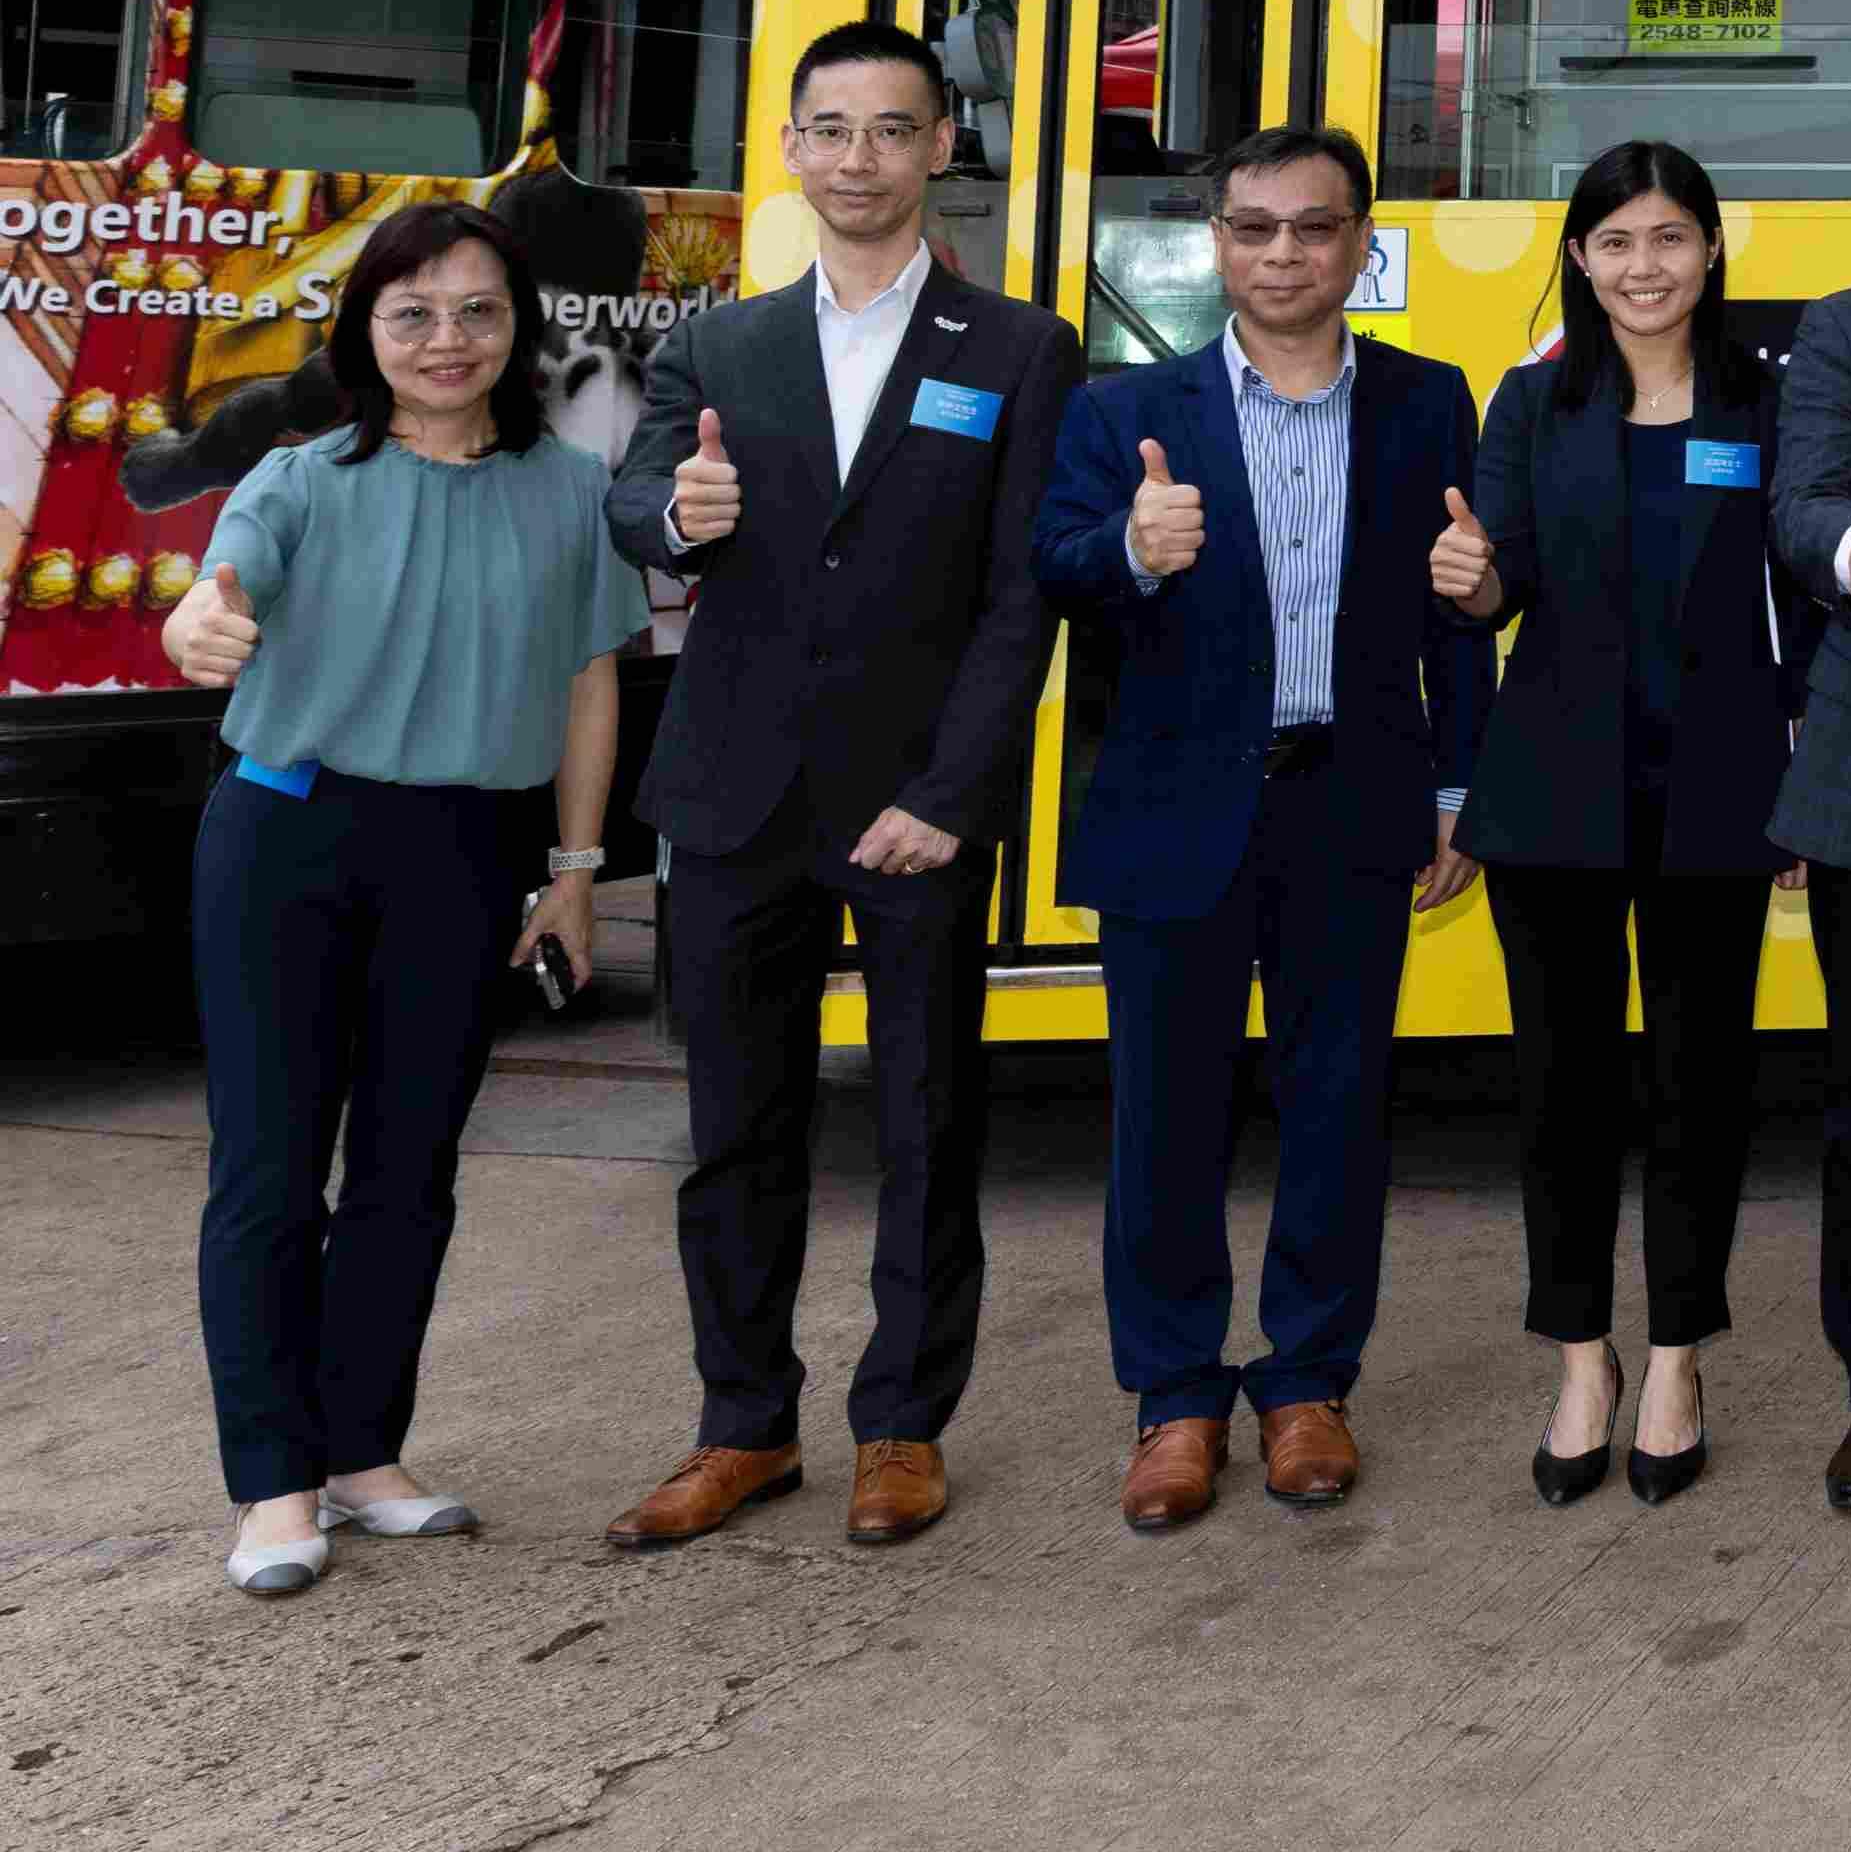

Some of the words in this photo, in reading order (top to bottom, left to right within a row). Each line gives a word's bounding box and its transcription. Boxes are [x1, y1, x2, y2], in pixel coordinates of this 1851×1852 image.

[1640, 23, 1771, 41] 2548-7102
[0, 275, 69, 312] We
[85, 279, 242, 317] Create
[252, 291, 278, 318] a
